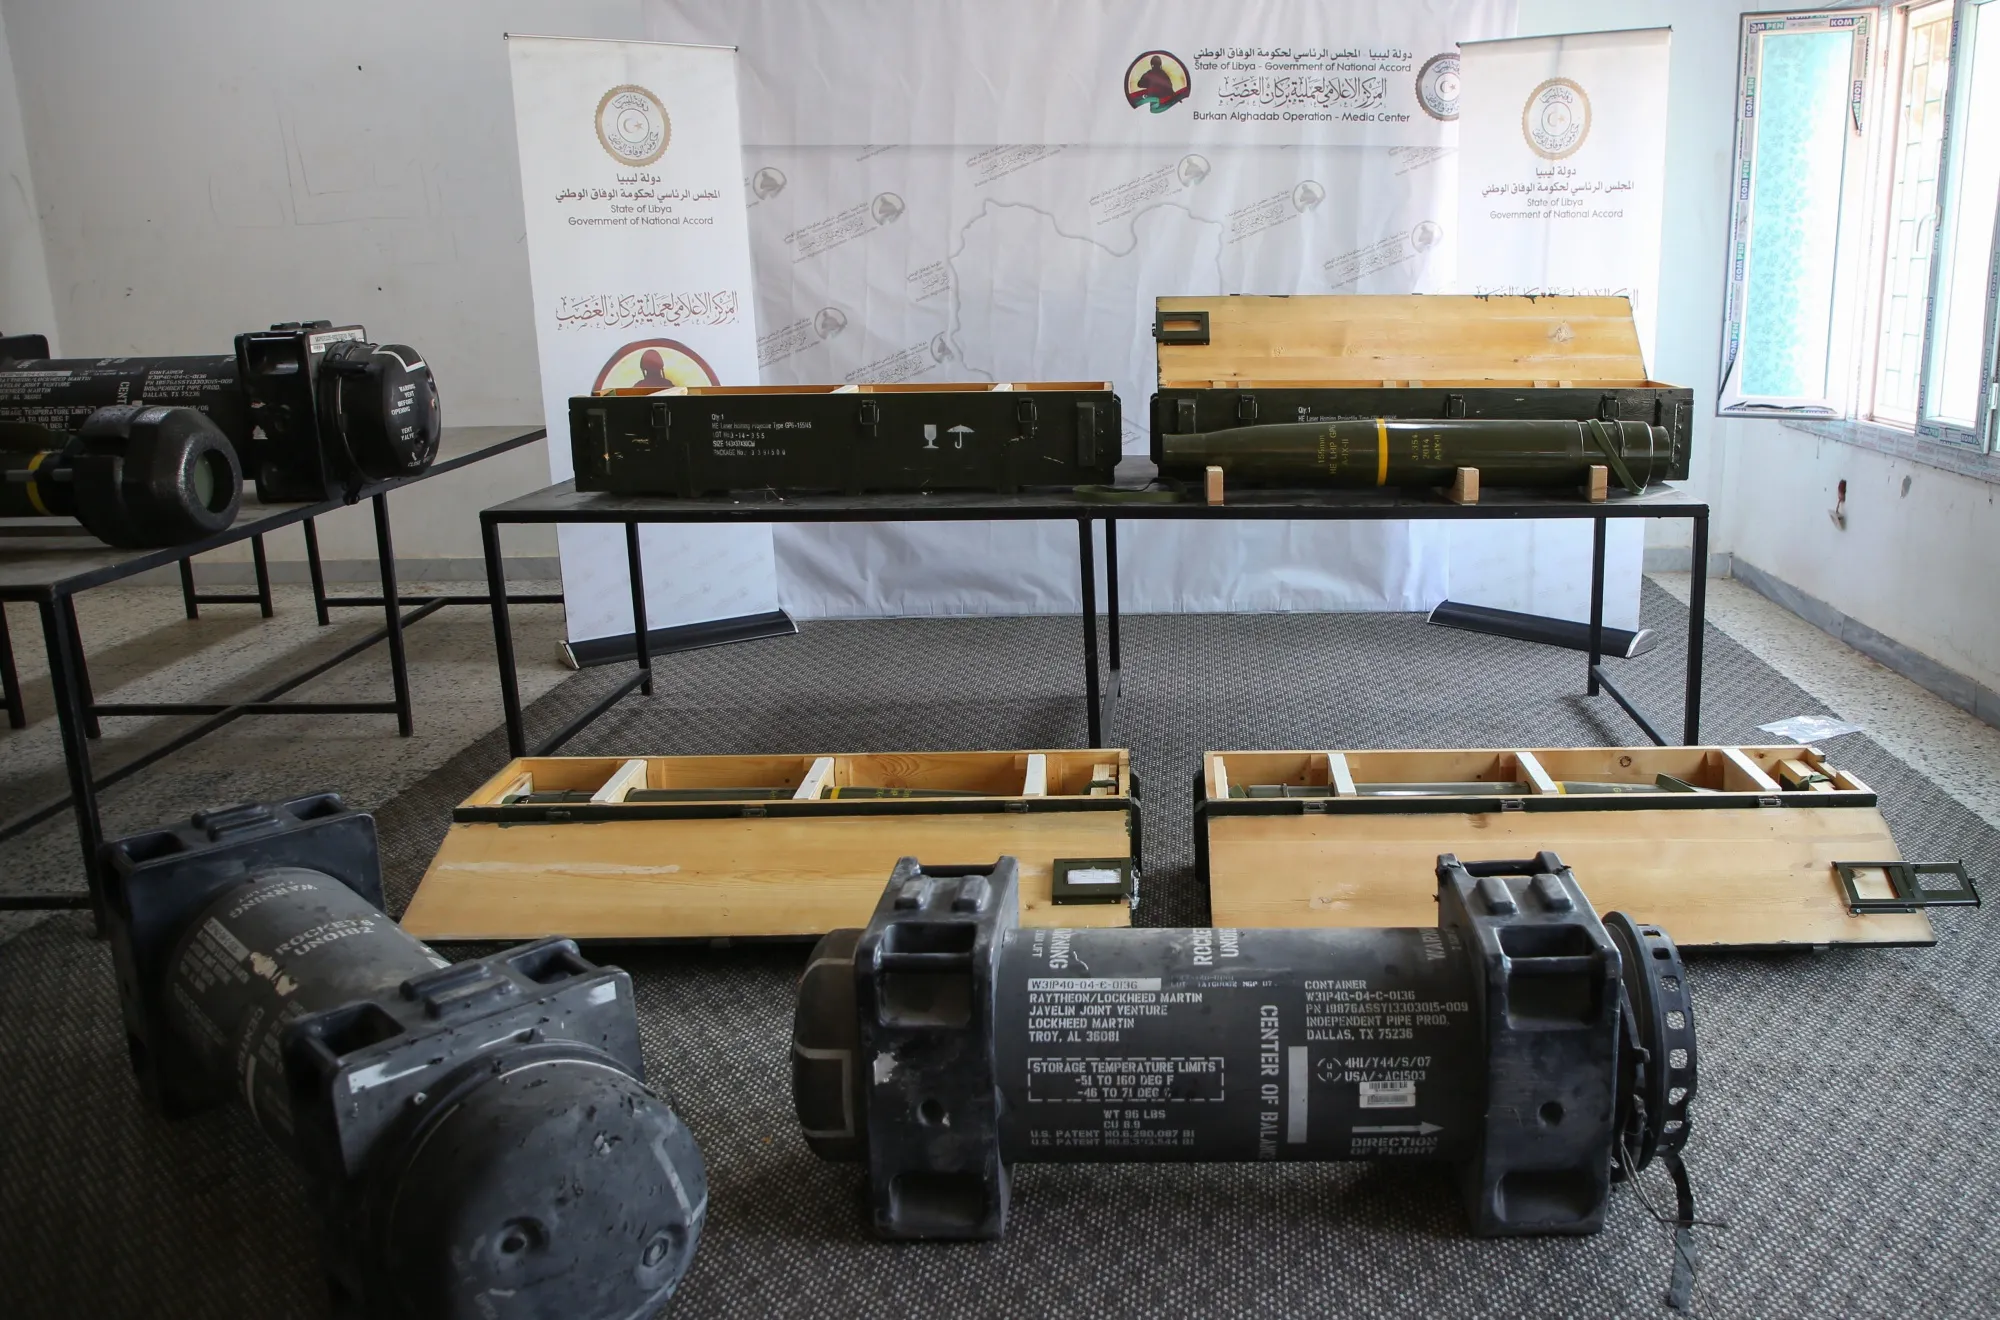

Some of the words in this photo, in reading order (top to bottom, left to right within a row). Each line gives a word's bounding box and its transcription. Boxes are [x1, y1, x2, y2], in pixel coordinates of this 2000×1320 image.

[1193, 48, 1225, 61] الوطني
[1227, 48, 1255, 59] الوفاق
[1257, 48, 1292, 60] لحكومة
[1330, 49, 1361, 60] المجلس
[1369, 49, 1390, 61] ليبيا
[1392, 50, 1413, 61] دولة
[1194, 62, 1218, 70] State
[1220, 62, 1231, 70] of
[1231, 62, 1256, 72] Libya
[1264, 62, 1323, 71] Government
[1325, 62, 1336, 71] of
[1337, 62, 1377, 71] National
[1379, 63, 1411, 72] Accord
[1193, 111, 1227, 120] Burkan
[1230, 111, 1279, 122] Alghadab
[1282, 111, 1332, 122] Operation
[1342, 112, 1375, 122] Media
[1378, 113, 1410, 122] Center
[1535, 166, 1555, 178] ليبيا
[1557, 166, 1576, 178] دولة
[616, 173, 638, 185] ليبيا
[640, 173, 661, 185] دولة
[555, 188, 588, 203] الوطني
[590, 188, 618, 201] الوفاق
[620, 188, 655, 200] لحكومة
[692, 189, 721, 201] المجلس
[1527, 198, 1548, 207] State
[1550, 198, 1560, 207] of
[1561, 197, 1583, 208] Libya
[610, 204, 634, 213] State
[636, 204, 647, 213] of
[648, 204, 672, 215] Libya
[1490, 210, 1541, 219] Government
[1543, 210, 1552, 219] of
[1553, 209, 1590, 218] National
[1591, 209, 1623, 218] Accord
[568, 216, 627, 225] Government
[629, 216, 640, 225] of
[641, 216, 680, 225] National
[682, 216, 713, 225] Accord
[117, 382, 130, 405] CENT
[275, 918, 376, 955] ROCKETS
[1304, 980, 1367, 990] CONTAINER
[1029, 992, 1156, 1004] RAYTHEON/LOCKHEED
[1160, 992, 1203, 1003] MARTIN
[1029, 1005, 1075, 1016] JAVELIN
[1080, 1005, 1112, 1016] JOINT
[1117, 1005, 1168, 1016] VENTURE
[1306, 1004, 1321, 1014] PN
[1028, 1018, 1088, 1029] LOCKHEED
[1092, 1018, 1135, 1028] MARTIN
[1306, 1015, 1382, 1027] INDEPENDENT
[1386, 1015, 1412, 1026] PIPE
[1028, 1031, 1063, 1043] TROY,
[1067, 1031, 1081, 1042] AL
[1086, 1031, 1120, 1042] 36081
[1260, 1004, 1279, 1076] CENTER
[1306, 1028, 1355, 1041] DALLAS,
[1359, 1028, 1374, 1040] TX
[1379, 1028, 1413, 1039] 75236
[1033, 1061, 1086, 1073] STORAGE
[1091, 1061, 1174, 1073] TEMPERATURE
[1177, 1061, 1217, 1073] LIMITS
[1074, 1075, 1092, 1086] -51
[1097, 1075, 1112, 1086] TO
[1116, 1075, 1136, 1086] 160
[1140, 1075, 1163, 1086] DEG
[1166, 1075, 1174, 1086] F
[1077, 1087, 1098, 1098] -46
[1102, 1087, 1117, 1098] TO
[1122, 1087, 1133, 1098] 71
[1137, 1087, 1159, 1098] DEG
[1260, 1083, 1279, 1105] OF
[1103, 1110, 1120, 1119] WT
[1125, 1110, 1139, 1119] 96
[1144, 1110, 1166, 1119] LBS
[1103, 1120, 1119, 1129] CU
[1056, 1130, 1100, 1138] PATENT
[1351, 1136, 1438, 1147] DIRECTION
